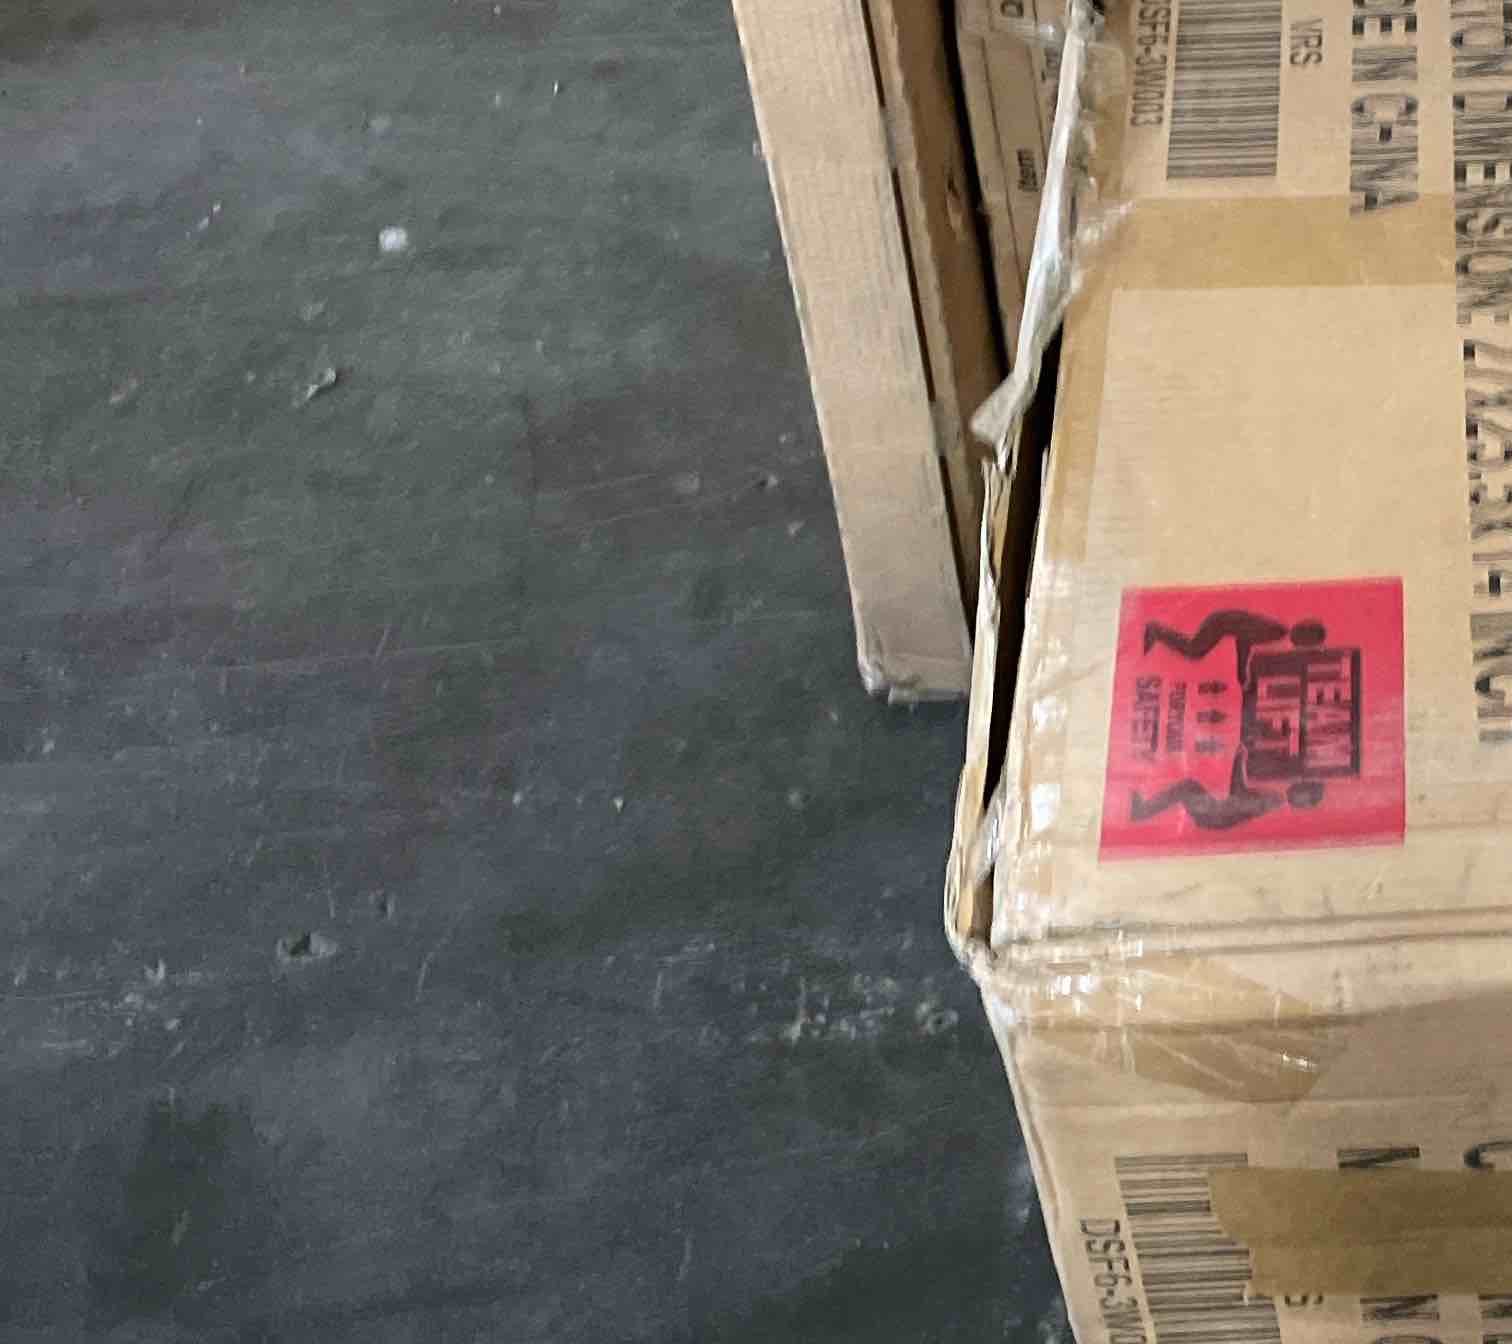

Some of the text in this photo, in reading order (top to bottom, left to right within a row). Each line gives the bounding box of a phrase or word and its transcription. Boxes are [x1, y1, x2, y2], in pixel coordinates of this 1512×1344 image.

[1352, 46, 1418, 81] IN
[1016, 148, 1039, 193] Item
[1350, 92, 1420, 217] CHINA
[1132, 676, 1163, 761] SAFETY
[1256, 674, 1303, 756] LIFT
[1306, 656, 1352, 769] TEAM
